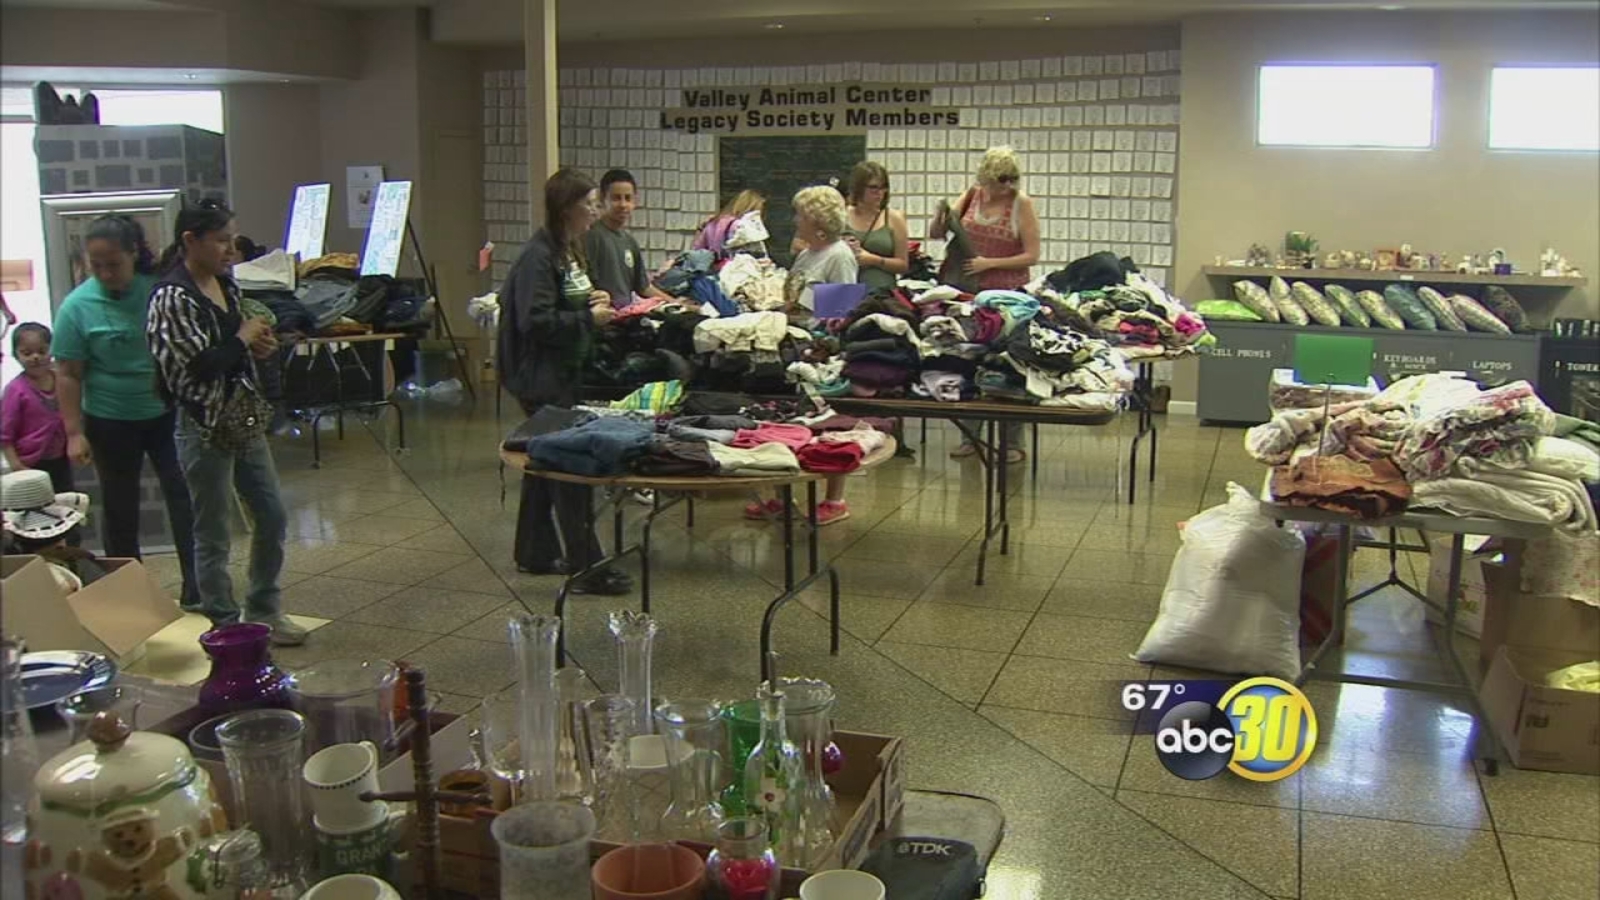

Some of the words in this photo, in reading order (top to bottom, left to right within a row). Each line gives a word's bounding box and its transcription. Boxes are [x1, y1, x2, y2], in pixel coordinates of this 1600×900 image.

[684, 89, 749, 111] Valley
[759, 87, 836, 106] Animal
[846, 85, 932, 103] Center
[660, 112, 738, 133] Legacy
[747, 110, 835, 131] Society
[846, 108, 959, 127] Members
[909, 842, 952, 856] TDK
